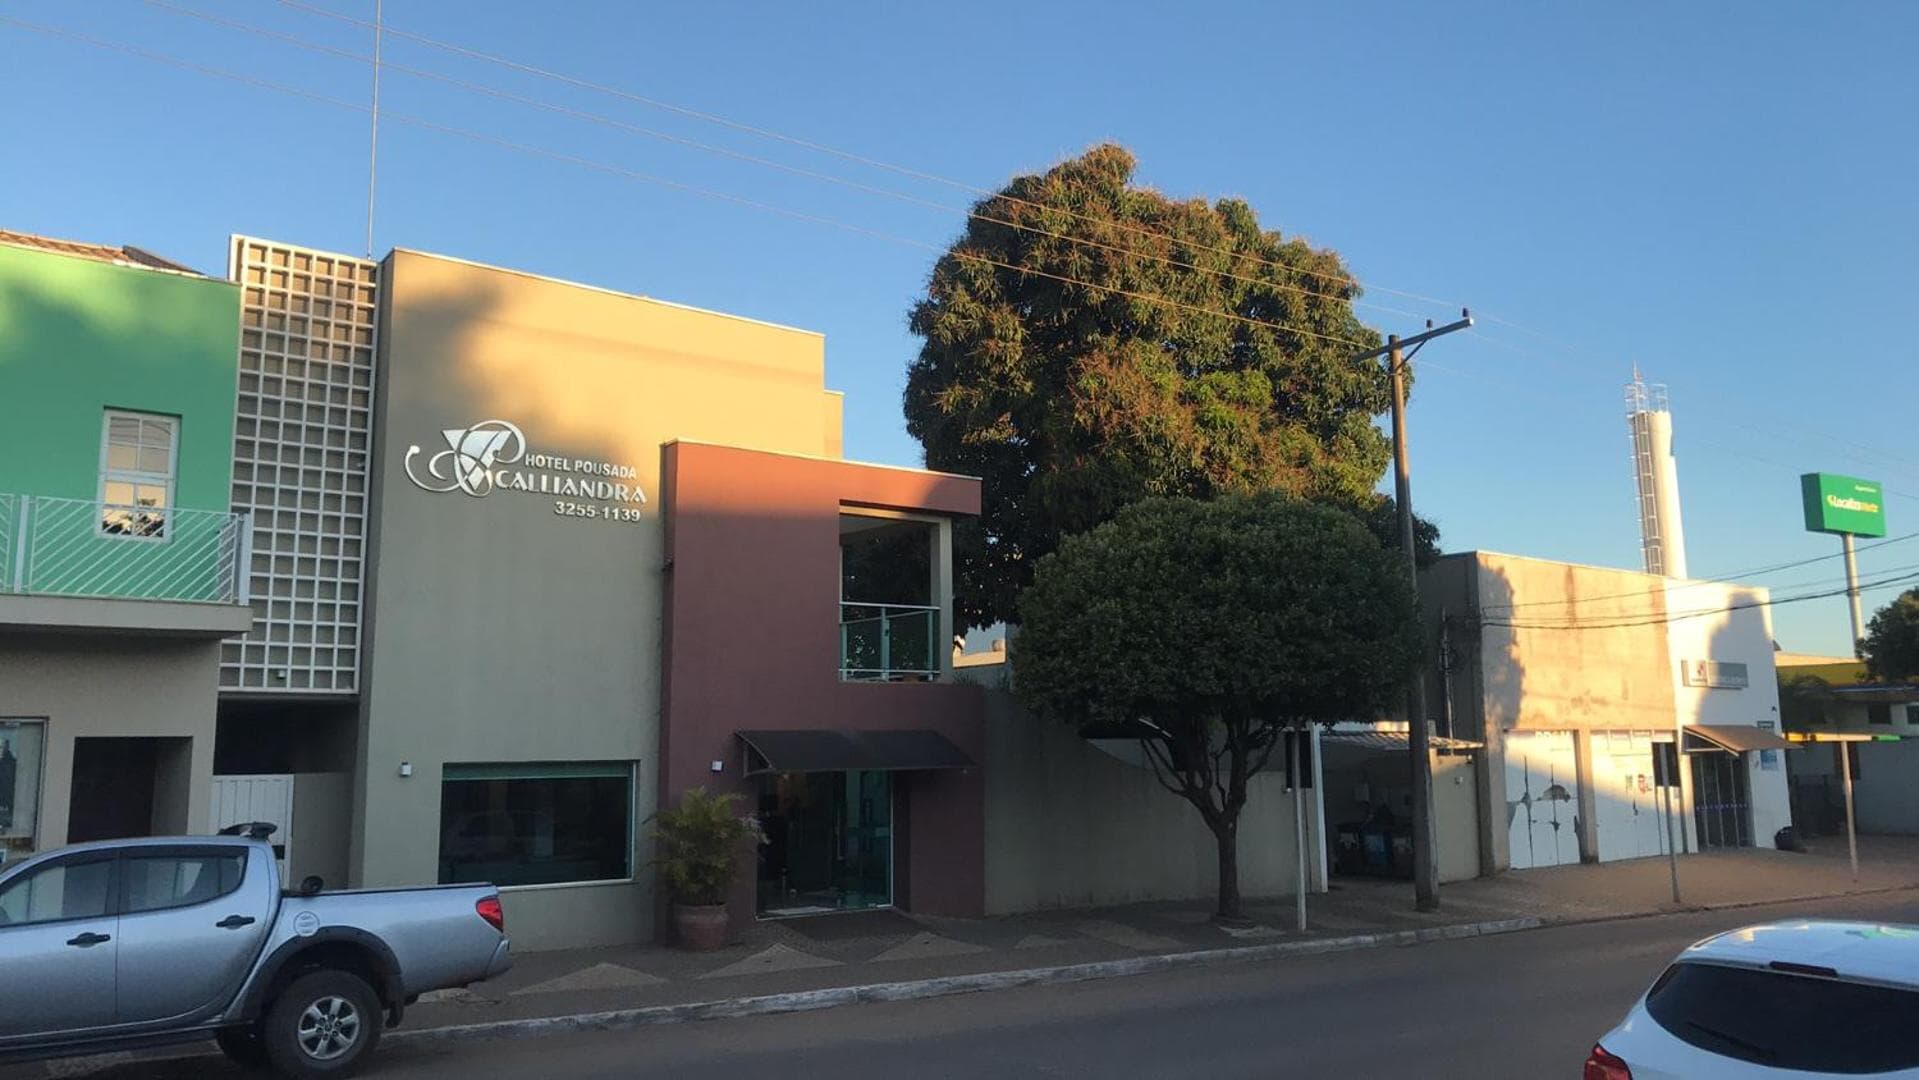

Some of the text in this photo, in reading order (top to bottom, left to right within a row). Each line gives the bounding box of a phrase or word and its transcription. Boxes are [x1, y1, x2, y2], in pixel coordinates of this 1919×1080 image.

[525, 453, 637, 480] HOTEL POUSADA
[495, 470, 647, 504] CALLIANDRA
[554, 500, 641, 522] 3255-1139
